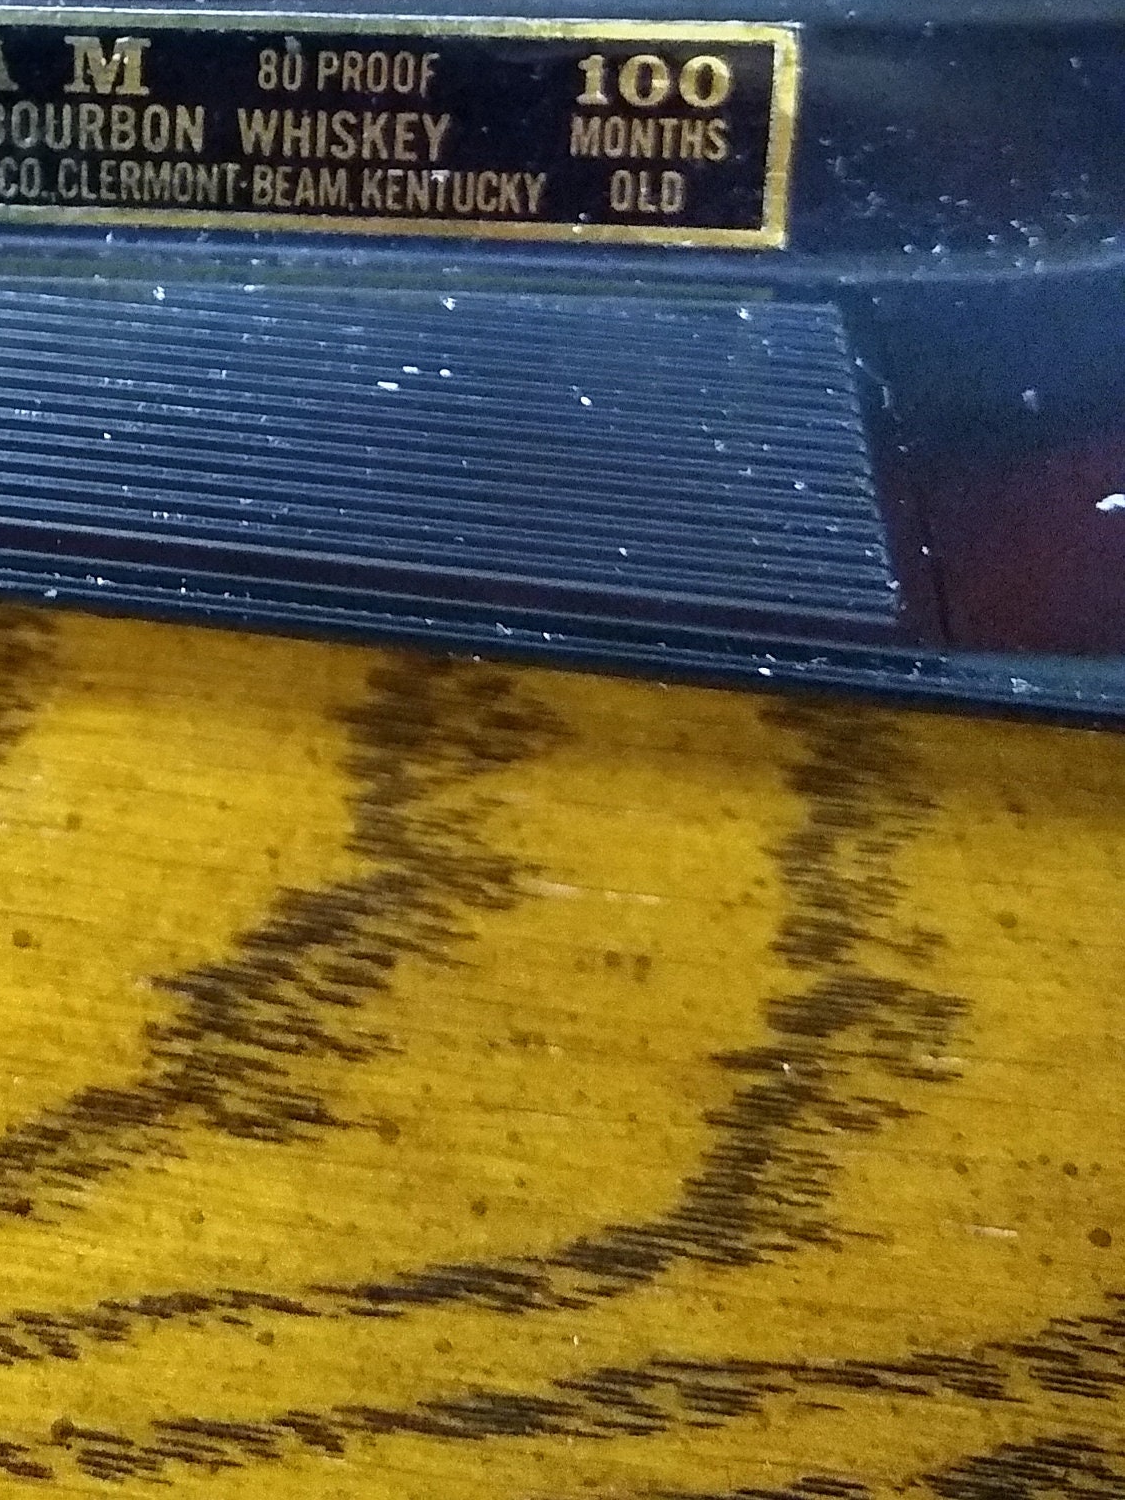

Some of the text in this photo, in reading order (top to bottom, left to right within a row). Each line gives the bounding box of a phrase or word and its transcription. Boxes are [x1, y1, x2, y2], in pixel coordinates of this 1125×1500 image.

[257, 49, 441, 97] 80 PROOF
[577, 53, 732, 108] 100
[237, 107, 451, 162] WHISKEY
[571, 116, 728, 160] MONTHS
[361, 168, 547, 214] KENTUCKY
[609, 170, 684, 214] OLD
